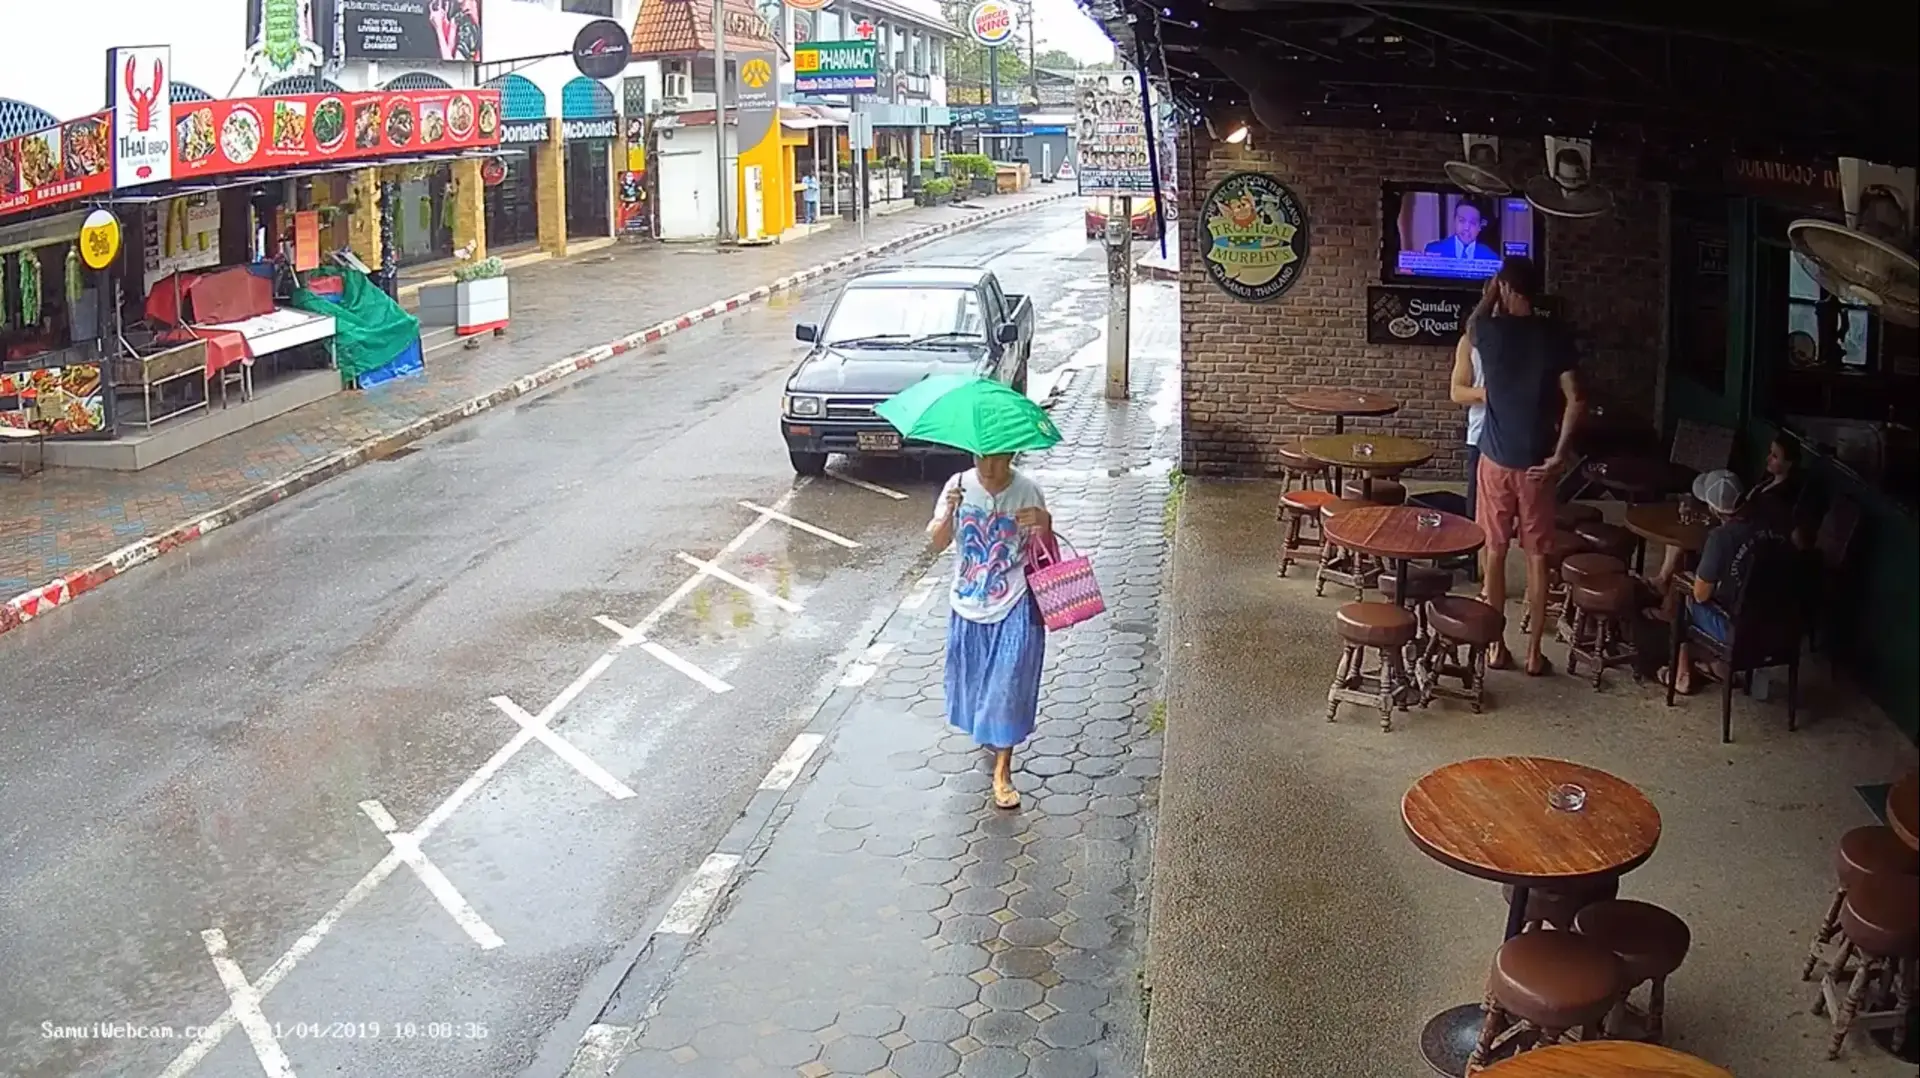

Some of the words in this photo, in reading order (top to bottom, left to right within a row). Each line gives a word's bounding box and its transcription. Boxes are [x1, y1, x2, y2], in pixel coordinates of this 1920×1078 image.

[381, 18, 398, 26] OPEN
[978, 17, 1009, 33] KING
[820, 48, 876, 69] PHARMACY
[148, 140, 169, 156] BBQ
[1253, 176, 1267, 187] ON
[1281, 194, 1301, 226] ISLAND
[1212, 221, 1291, 238] TROPICAL
[1212, 247, 1291, 264] MURPHY'S
[1223, 276, 1252, 298] SAMUI
[1255, 265, 1294, 297] THAILAND
[1409, 299, 1460, 319] Sunday
[1419, 318, 1460, 337] Roast
